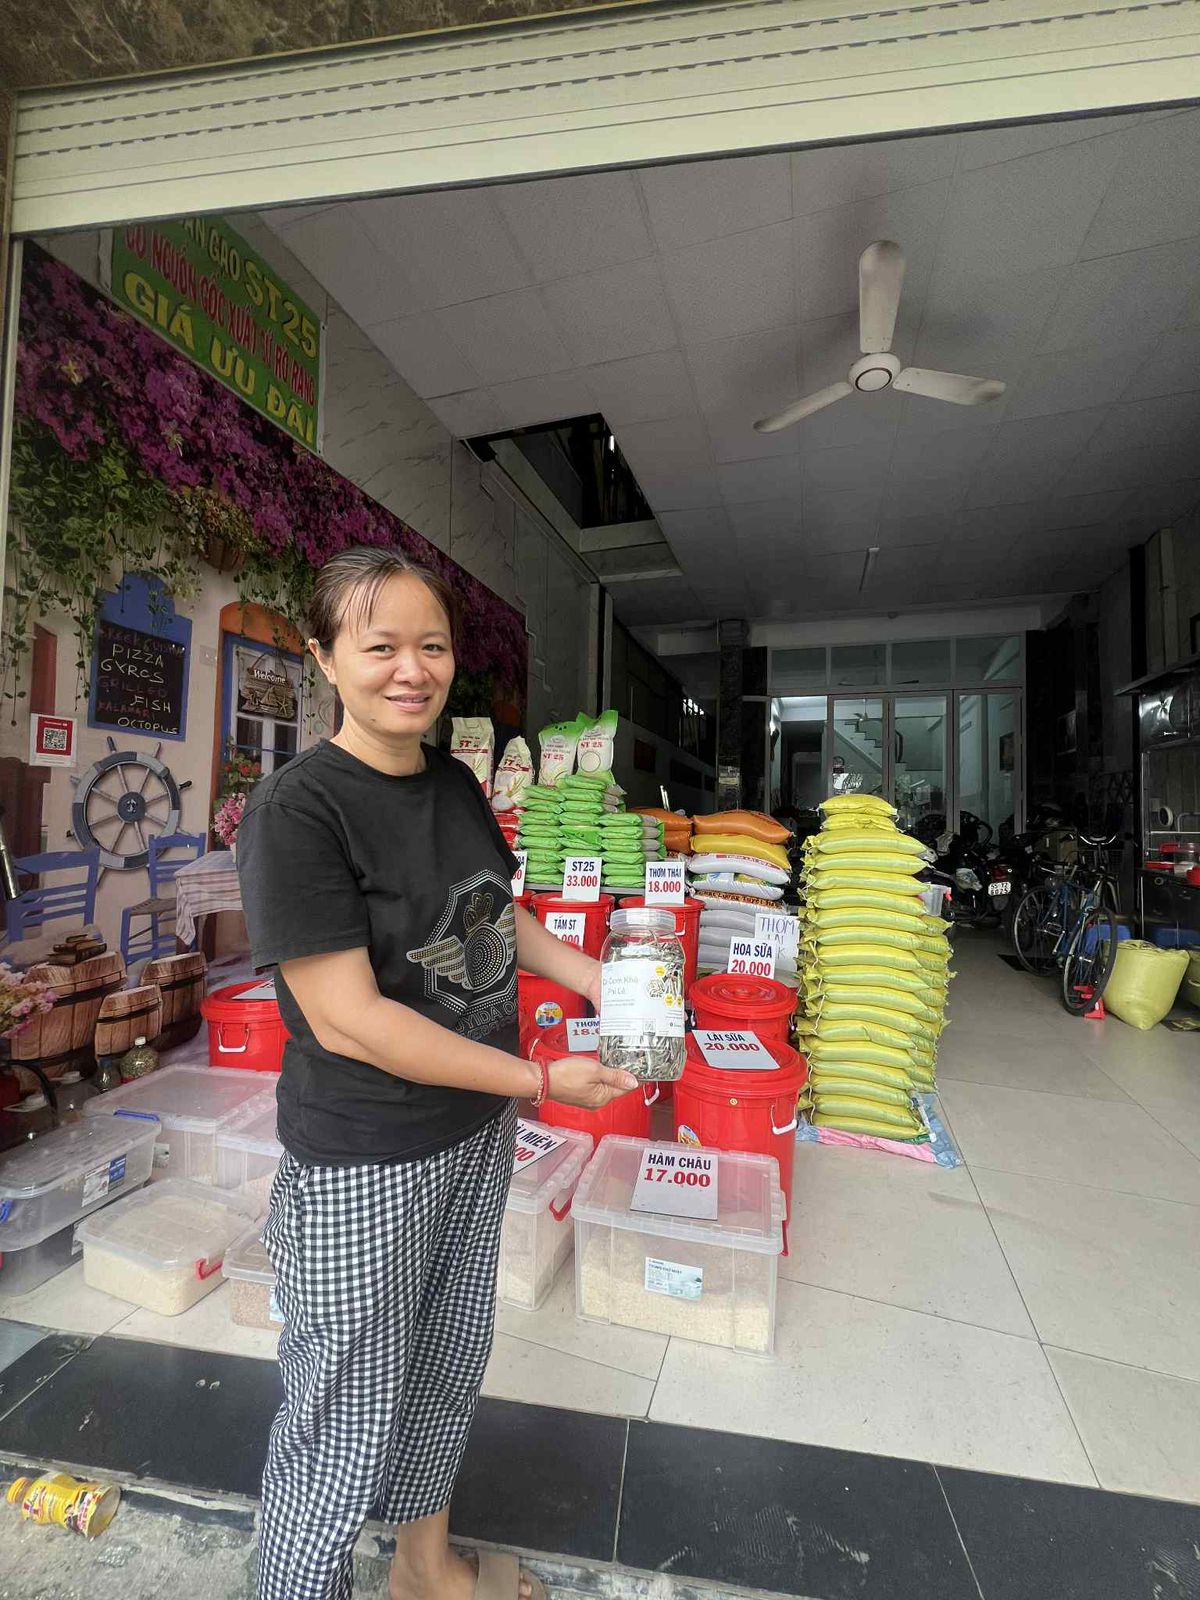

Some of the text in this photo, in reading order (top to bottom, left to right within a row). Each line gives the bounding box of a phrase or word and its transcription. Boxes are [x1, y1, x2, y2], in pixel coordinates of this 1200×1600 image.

[124, 272, 194, 350] GIÁ
[211, 337, 256, 396] ƯU
[112, 643, 164, 668] PIZZA
[254, 668, 286, 684] Welcome
[130, 695, 171, 713] FISH
[117, 717, 179, 735] OCTOPUS
[572, 861, 595, 872] ST25
[649, 867, 666, 878] THƠM
[566, 875, 598, 887] 33.000
[648, 881, 681, 893] 18.000
[554, 915, 577, 930] TẤM ST
[733, 942, 751, 956] HOA
[754, 943, 773, 959] SỮA
[730, 959, 771, 976] 20.000
[725, 1033, 745, 1042] SỮA
[704, 1043, 760, 1051] 20.000
[648, 1151, 711, 1170] HÀM CHÂU
[644, 1168, 711, 1187] 17.000
